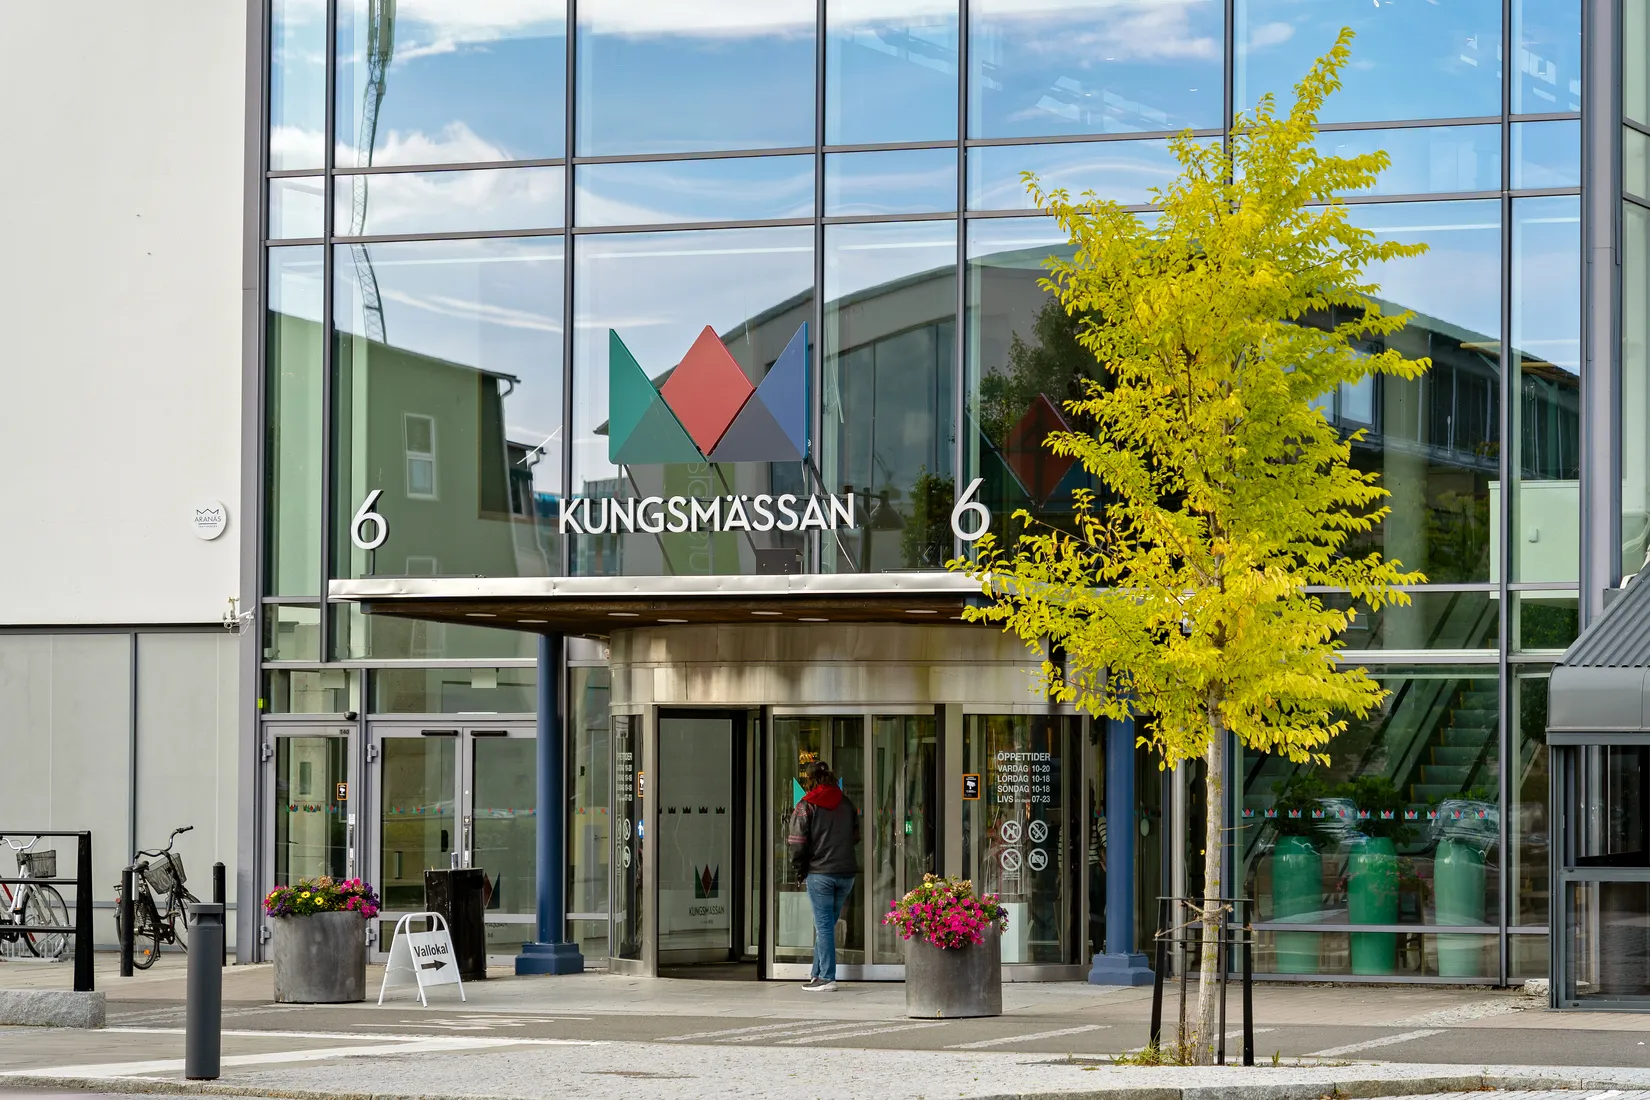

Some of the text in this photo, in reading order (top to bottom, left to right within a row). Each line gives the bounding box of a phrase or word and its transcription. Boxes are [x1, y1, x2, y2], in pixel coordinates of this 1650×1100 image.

[559, 493, 856, 534] KUNGSMÄSSAN
[951, 477, 991, 541] 6
[351, 489, 388, 550] 6
[997, 750, 1051, 761] ÖPPETTIDER
[997, 764, 1051, 773] VARDAG 10-20
[997, 773, 1051, 783] LÖRDAG 10-18
[997, 783, 1051, 793] SÖNDAG 10-18
[997, 795, 1014, 803] LIVS
[1031, 795, 1051, 803] 07-23
[413, 942, 449, 958] Vallokal
